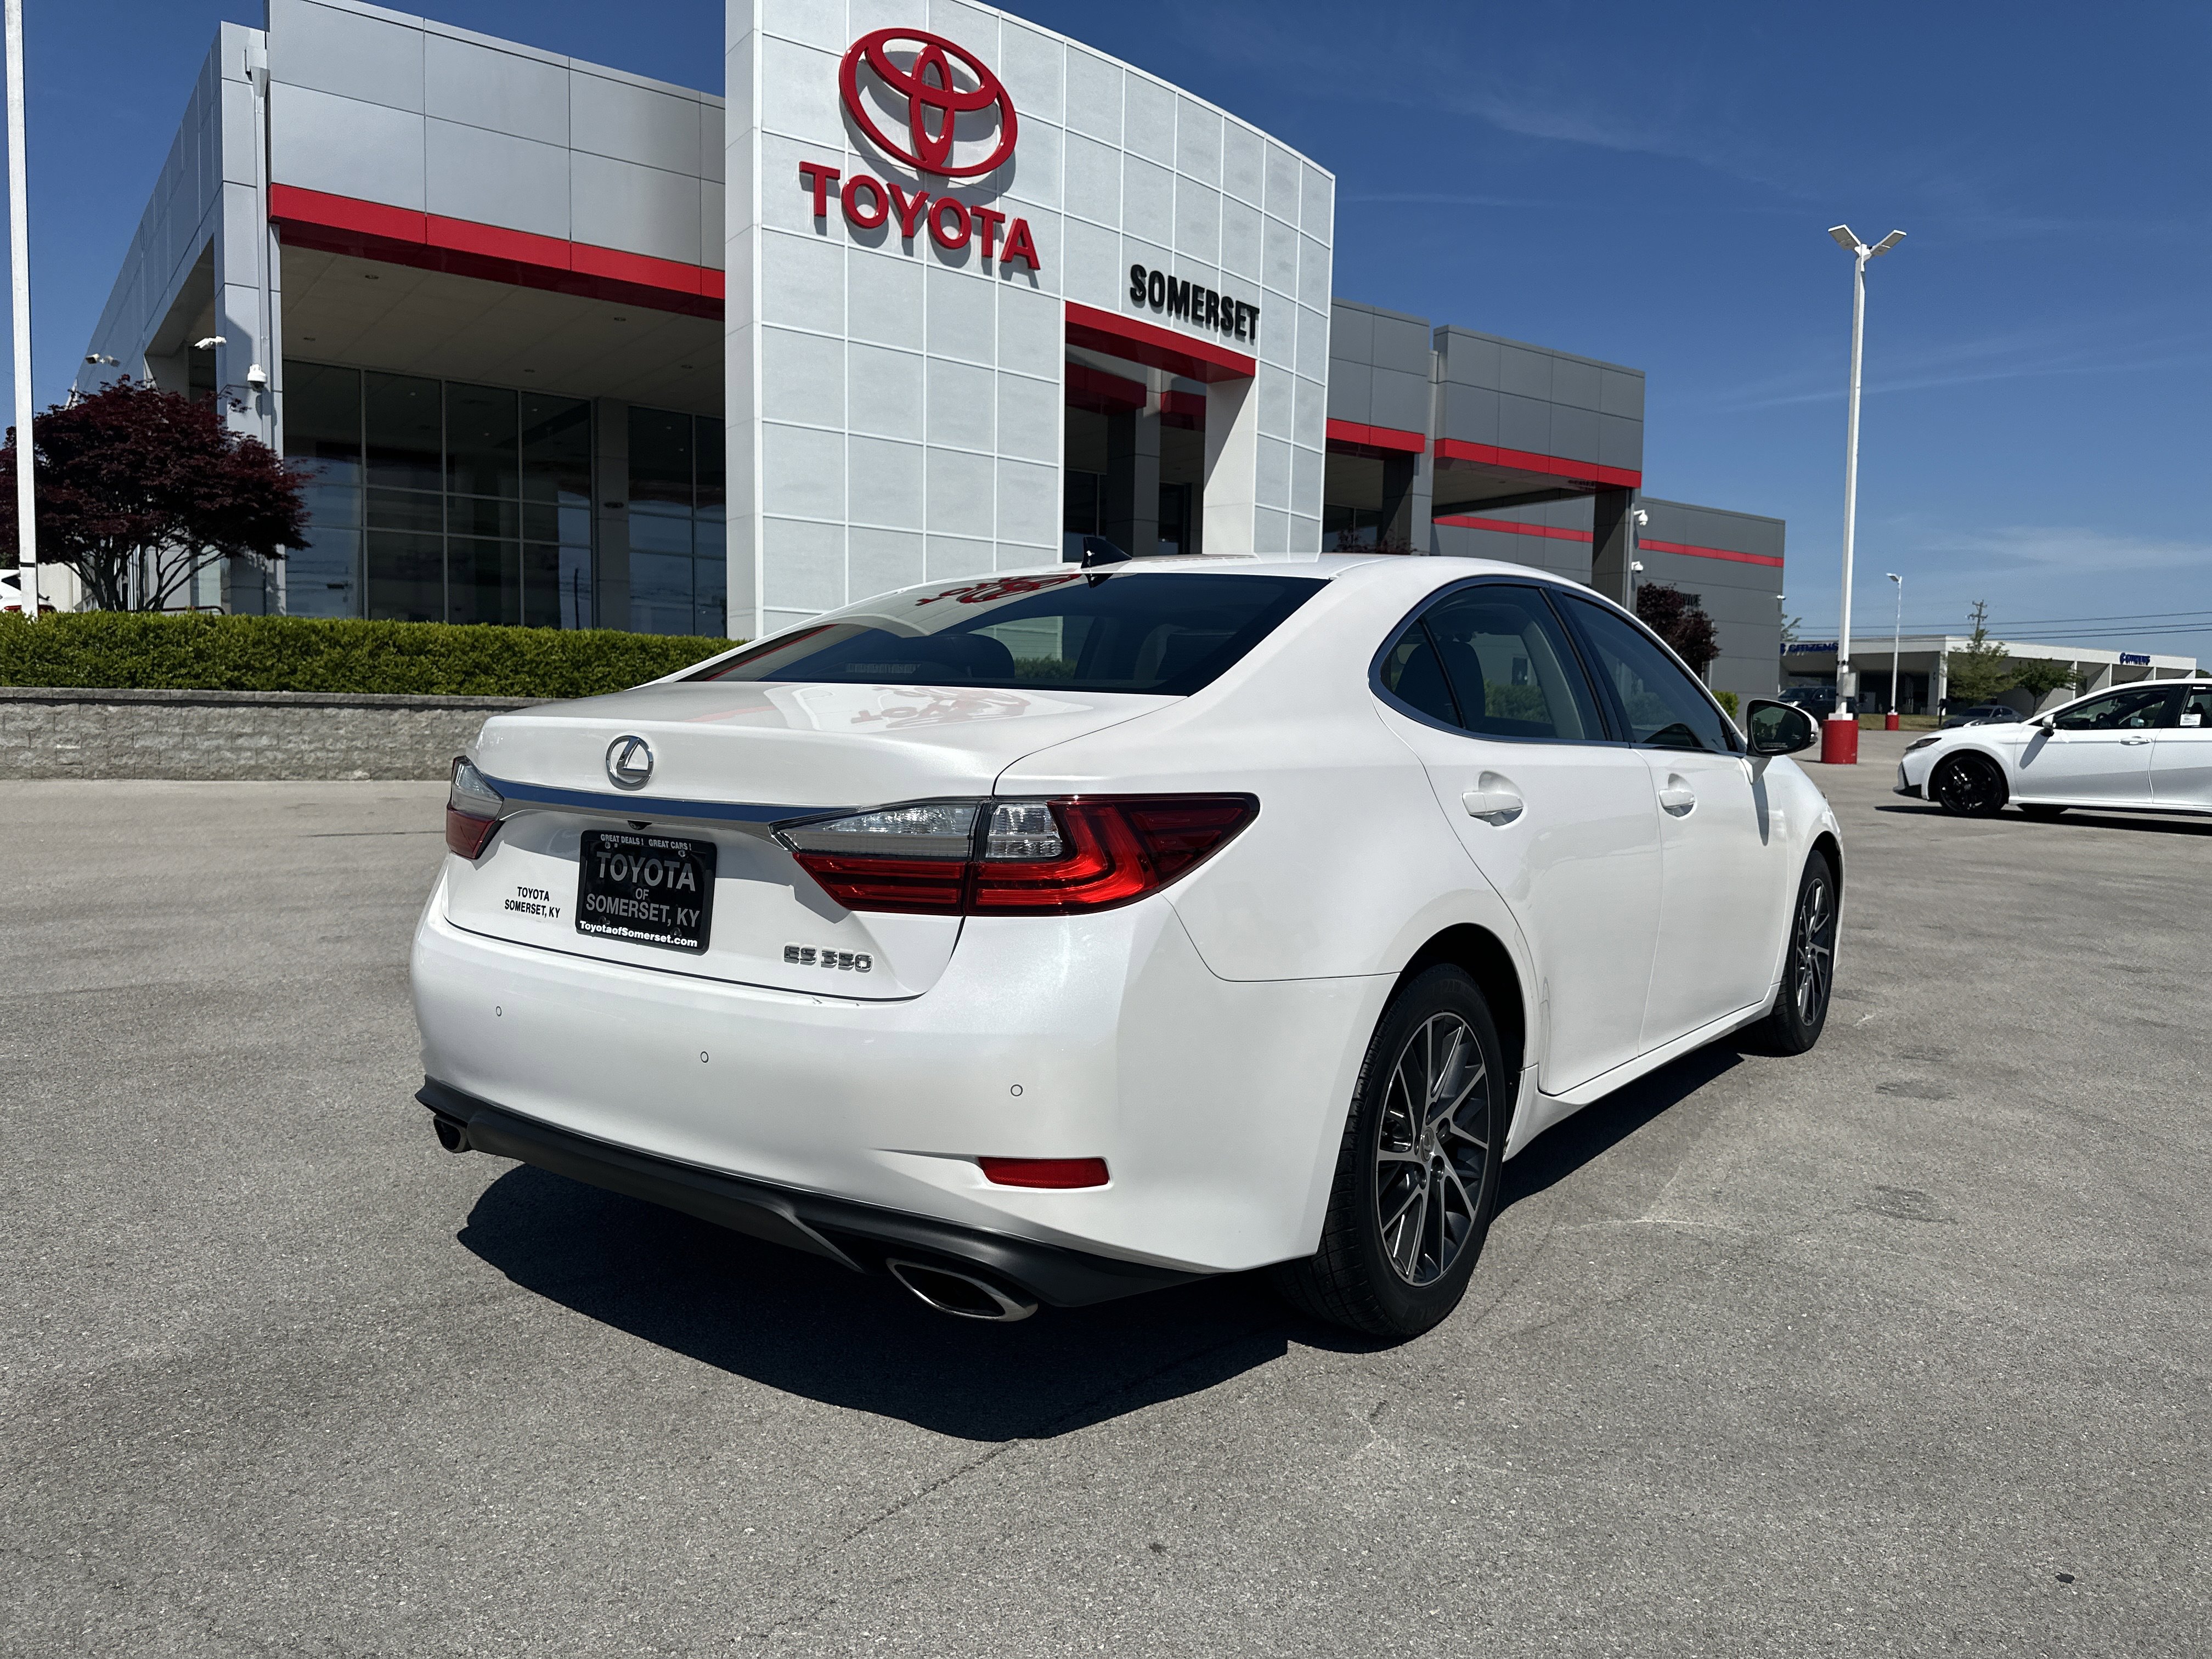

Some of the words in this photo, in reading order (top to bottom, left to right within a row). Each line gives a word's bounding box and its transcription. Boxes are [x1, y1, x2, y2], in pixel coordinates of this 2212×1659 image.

[799, 161, 1041, 270] TOYOTA
[1130, 264, 1260, 340] SOMERSET
[600, 834, 619, 843] GREAT
[648, 839, 669, 848] GREAT
[597, 851, 696, 891] TOYOTA
[517, 887, 550, 901] TOYOTA
[635, 888, 650, 900] OF
[505, 899, 547, 918] SOMERSET,
[549, 906, 561, 918] KY
[586, 893, 670, 927] SOMERSET,
[676, 907, 700, 928] KY
[579, 920, 698, 947] ToyotaofSomerset.com
[784, 945, 817, 966] ES
[821, 949, 873, 973] 350
